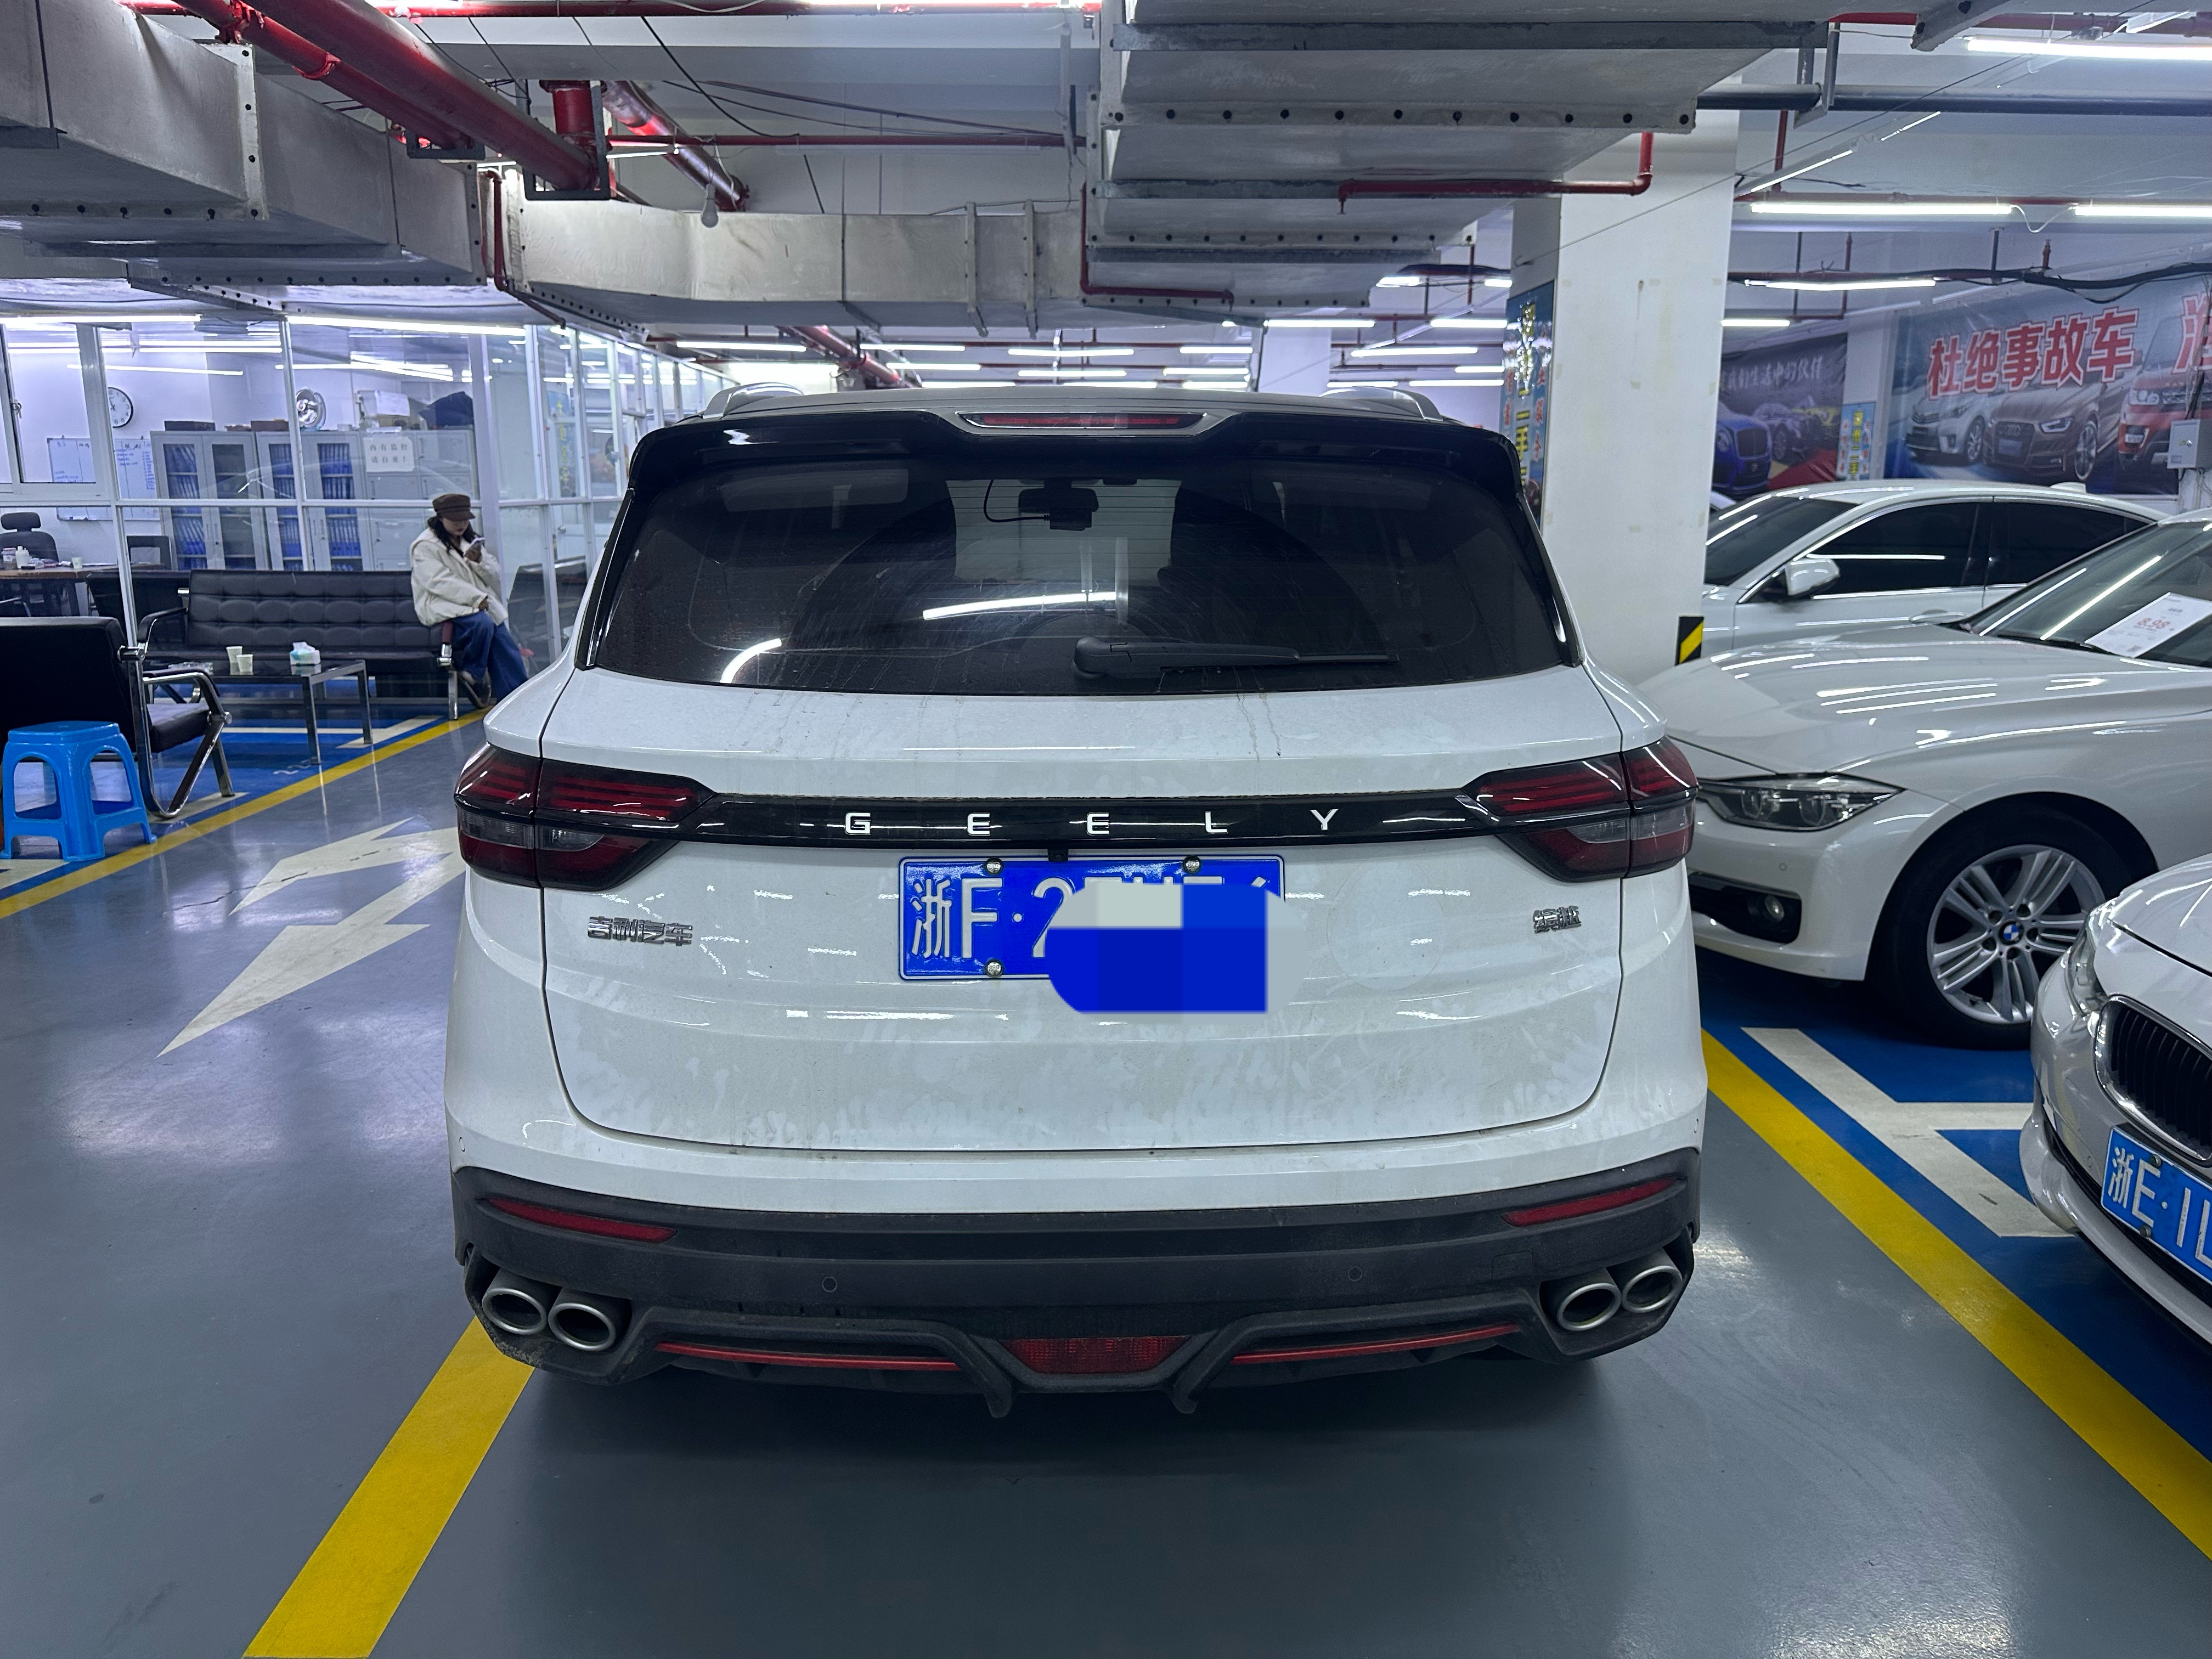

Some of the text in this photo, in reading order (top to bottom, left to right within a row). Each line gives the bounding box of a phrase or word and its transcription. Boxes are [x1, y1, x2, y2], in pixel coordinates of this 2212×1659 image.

[1927, 306, 2140, 401] 杜绝事故车
[844, 808, 1339, 837] GEELY
[588, 916, 693, 946] 吉利汽车
